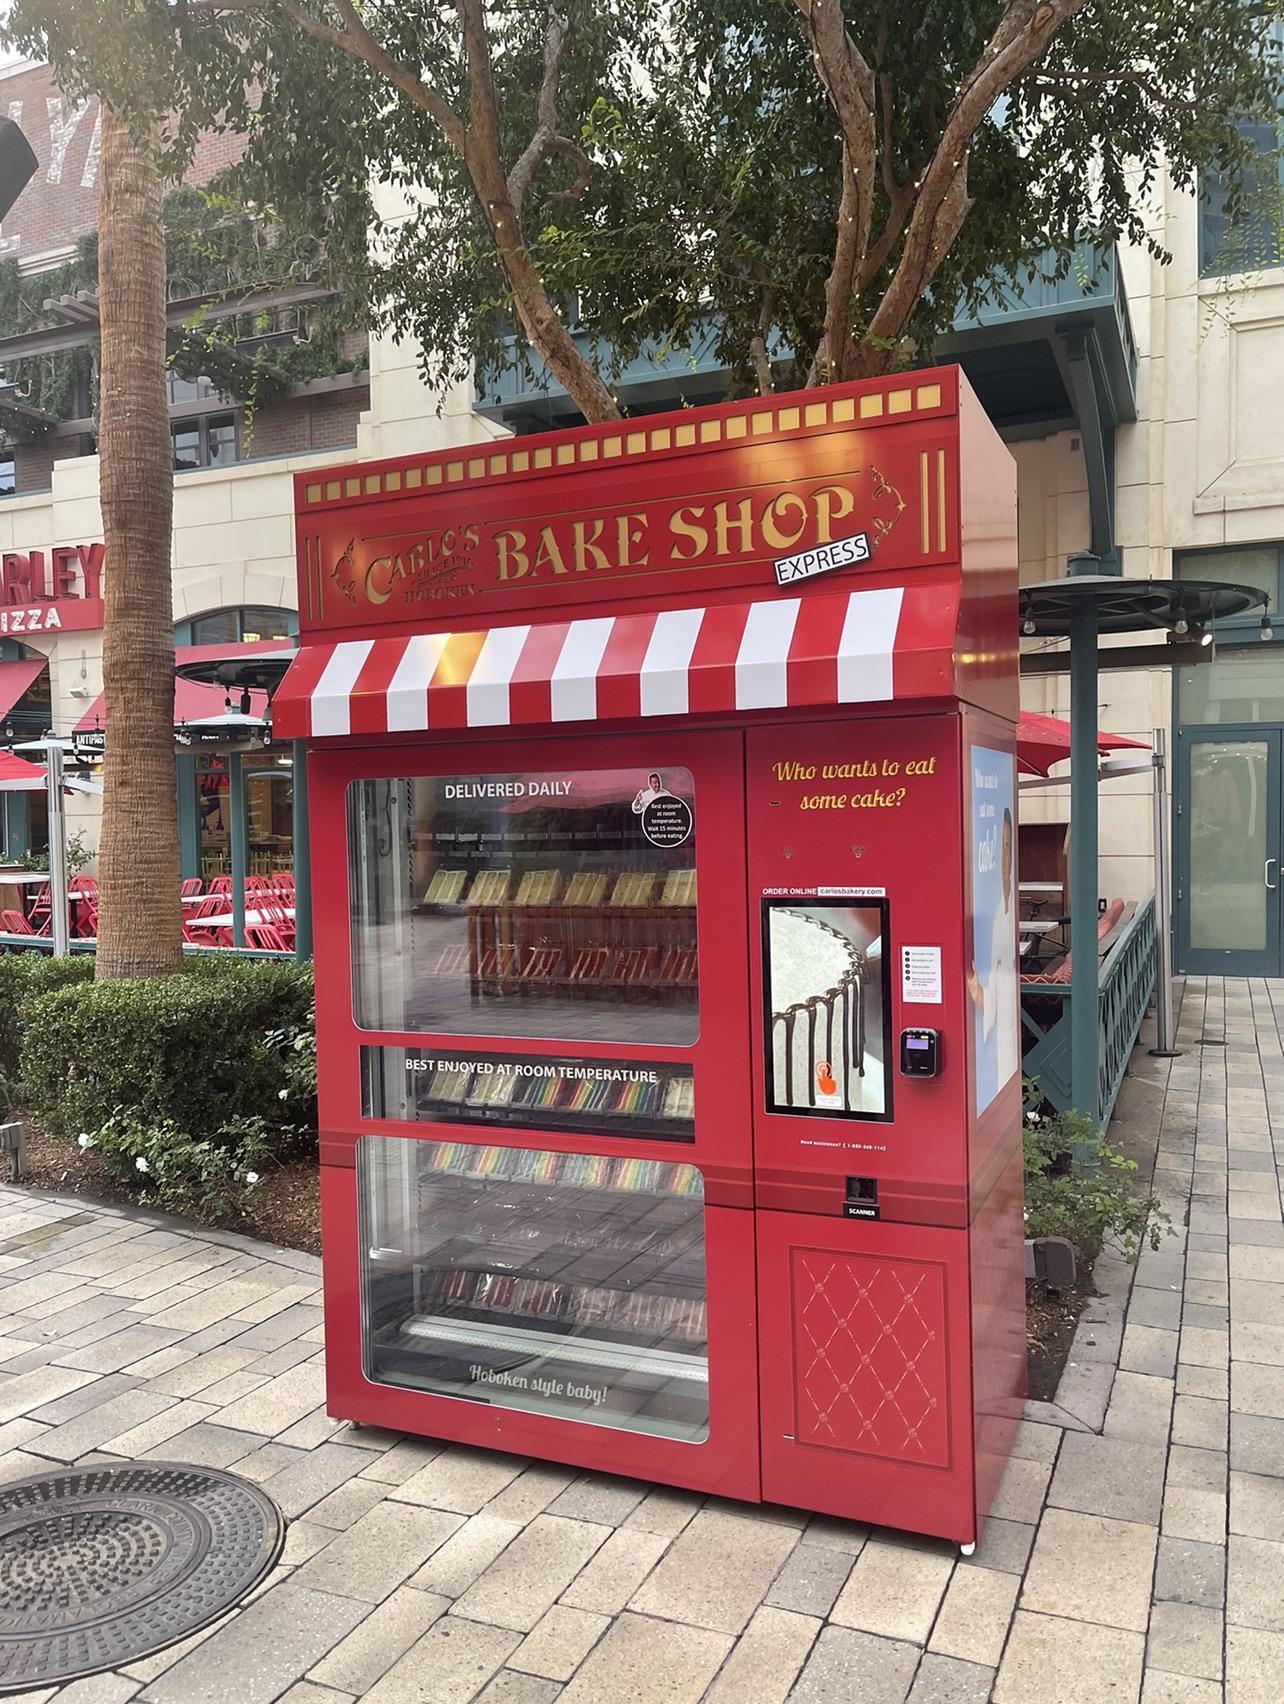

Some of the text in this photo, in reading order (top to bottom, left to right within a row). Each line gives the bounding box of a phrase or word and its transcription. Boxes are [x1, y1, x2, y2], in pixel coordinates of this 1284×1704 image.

[493, 485, 855, 581] BAKE SHOP
[778, 537, 868, 583] EXPRESS
[0, 543, 105, 606] RLEY
[404, 584, 475, 603] HOBOKEN
[772, 756, 936, 781] Who wants to eat
[445, 781, 572, 799] DELIVERED DAILY
[800, 788, 906, 810] some cake?
[762, 887, 883, 896] ORDER ONLINE carlosbakery.com
[405, 1058, 657, 1083] BEST ENJOYED AT ROOM TEMPERATURE
[848, 1207, 876, 1217] SCANNER
[469, 1364, 608, 1407] Hoboken style baby!
